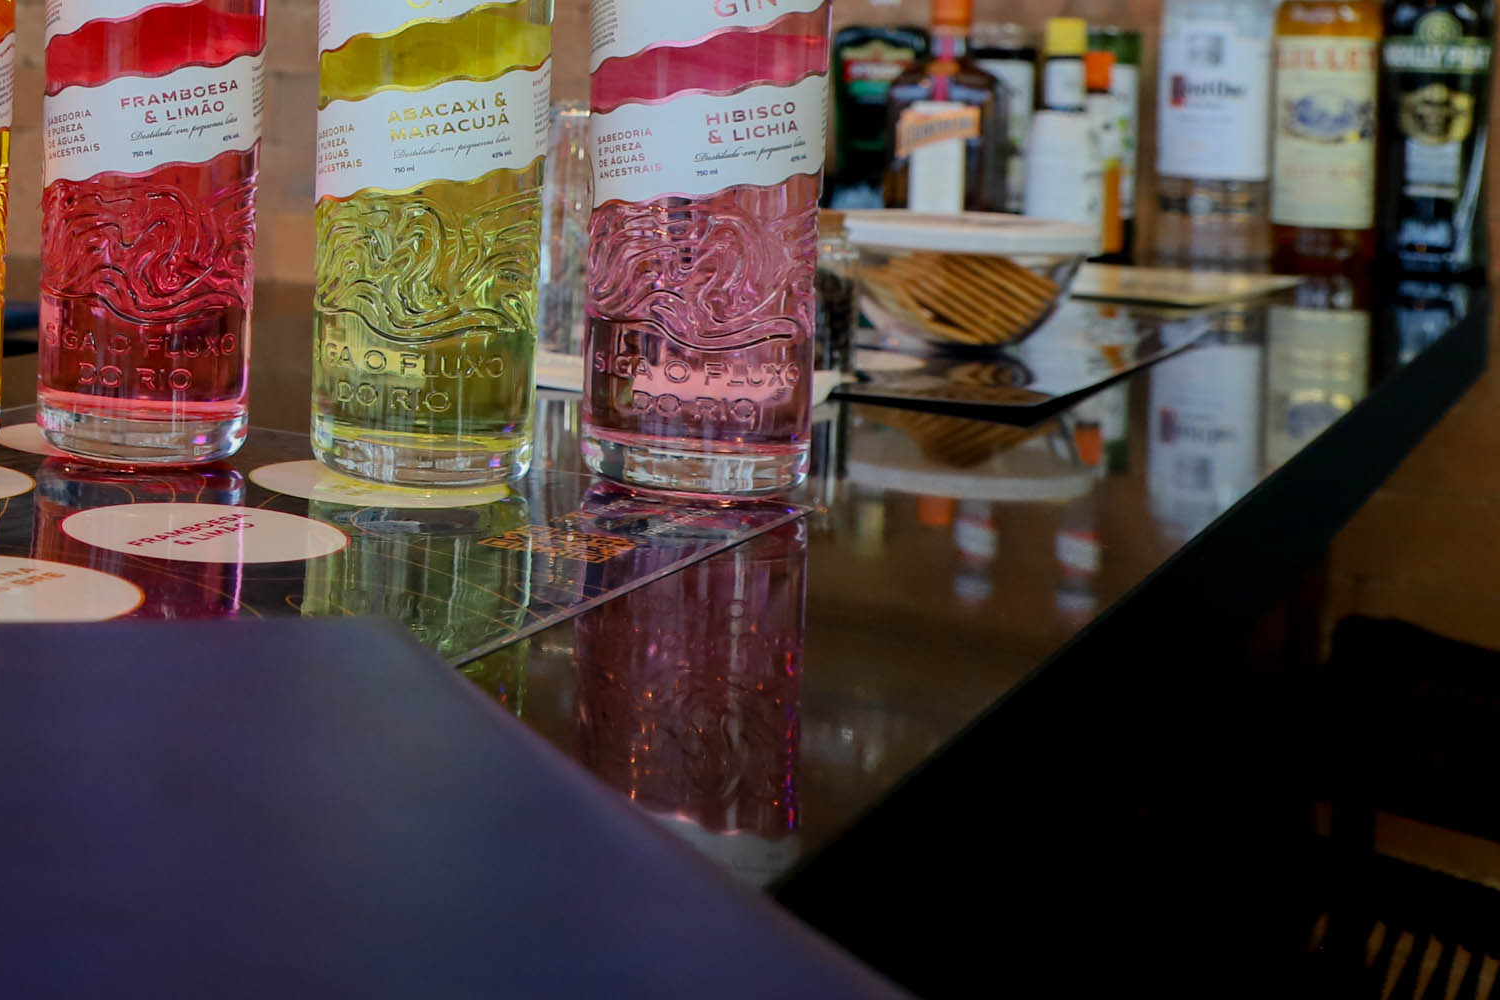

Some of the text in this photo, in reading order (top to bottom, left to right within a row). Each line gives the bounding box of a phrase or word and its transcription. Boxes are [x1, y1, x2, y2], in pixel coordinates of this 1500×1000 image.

[120, 80, 238, 109] FRAMBOESA
[145, 100, 225, 124] & LIMÃO
[388, 92, 507, 124] ABACAXI &
[706, 102, 796, 126] HIBISCO
[52, 123, 83, 136] PUREZA
[389, 108, 509, 142] MARACUJÁ
[597, 128, 652, 145] SABEDORIA
[708, 120, 799, 144] & LICHIA
[57, 132, 85, 146] ÁGUAS
[604, 142, 642, 155] PUREZA
[599, 152, 645, 168] DE ÁGUAS
[600, 163, 663, 180] ANCESTRAIS
[45, 322, 237, 359] SIGA O FLUXO
[78, 363, 193, 391] DO RIO
[363, 350, 504, 378] O FLUXO
[664, 360, 691, 384] O
[703, 361, 800, 388] FLUXO
[337, 380, 452, 412] DO RIO
[632, 390, 682, 416] DO
[126, 513, 253, 546] FRAMBOESA
